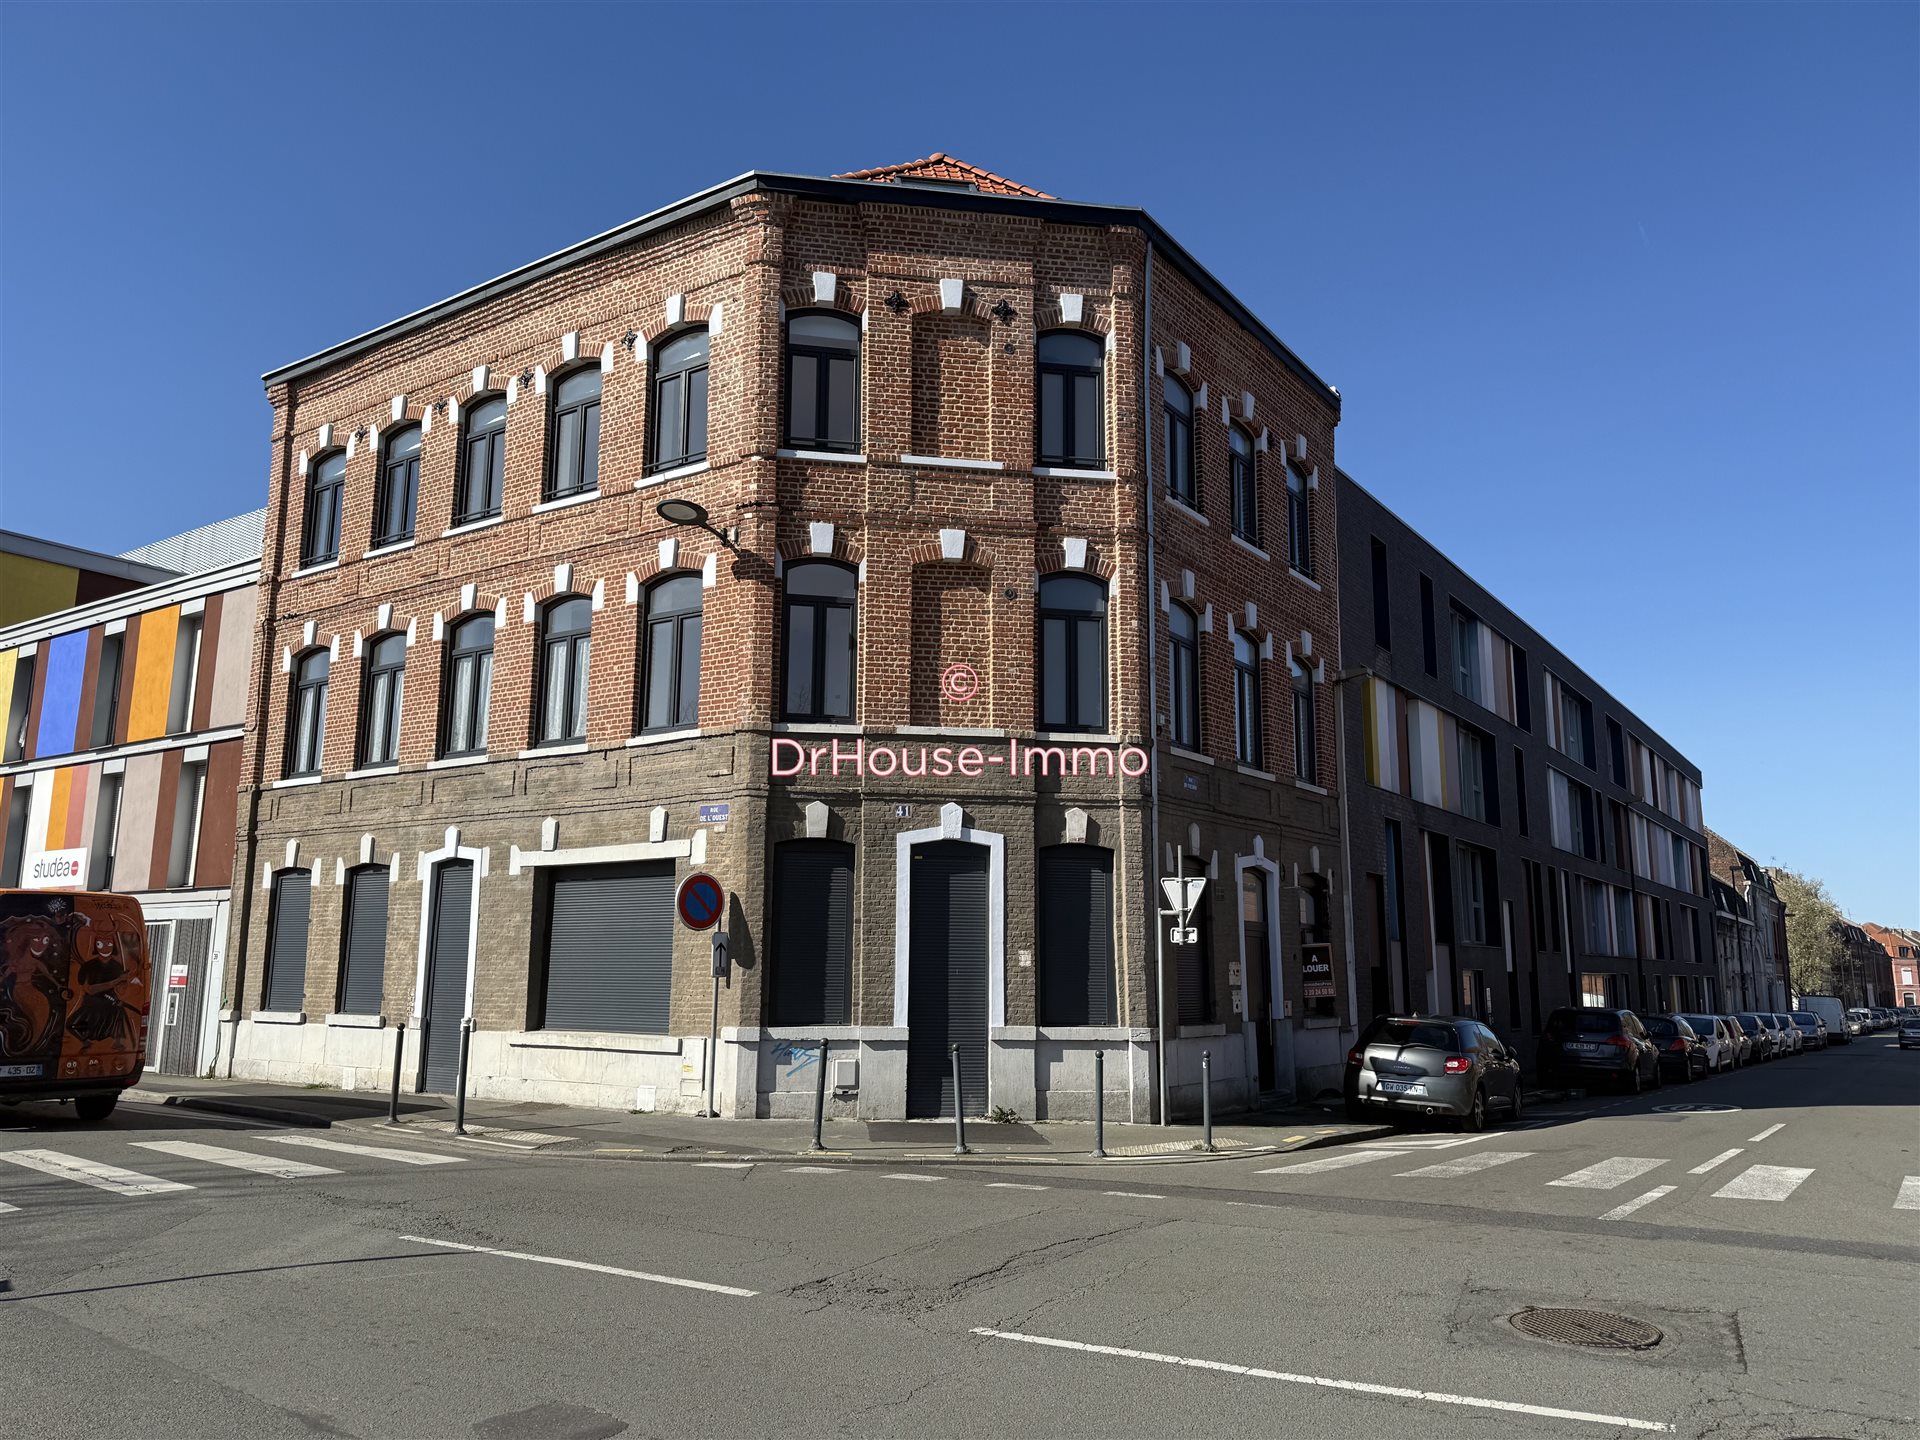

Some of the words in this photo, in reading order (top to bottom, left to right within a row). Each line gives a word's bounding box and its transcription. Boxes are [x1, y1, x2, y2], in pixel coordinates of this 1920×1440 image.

[896, 805, 909, 817] 41
[33, 856, 70, 878] studéa
[1311, 954, 1319, 963] A
[1302, 963, 1330, 973] LOUER
